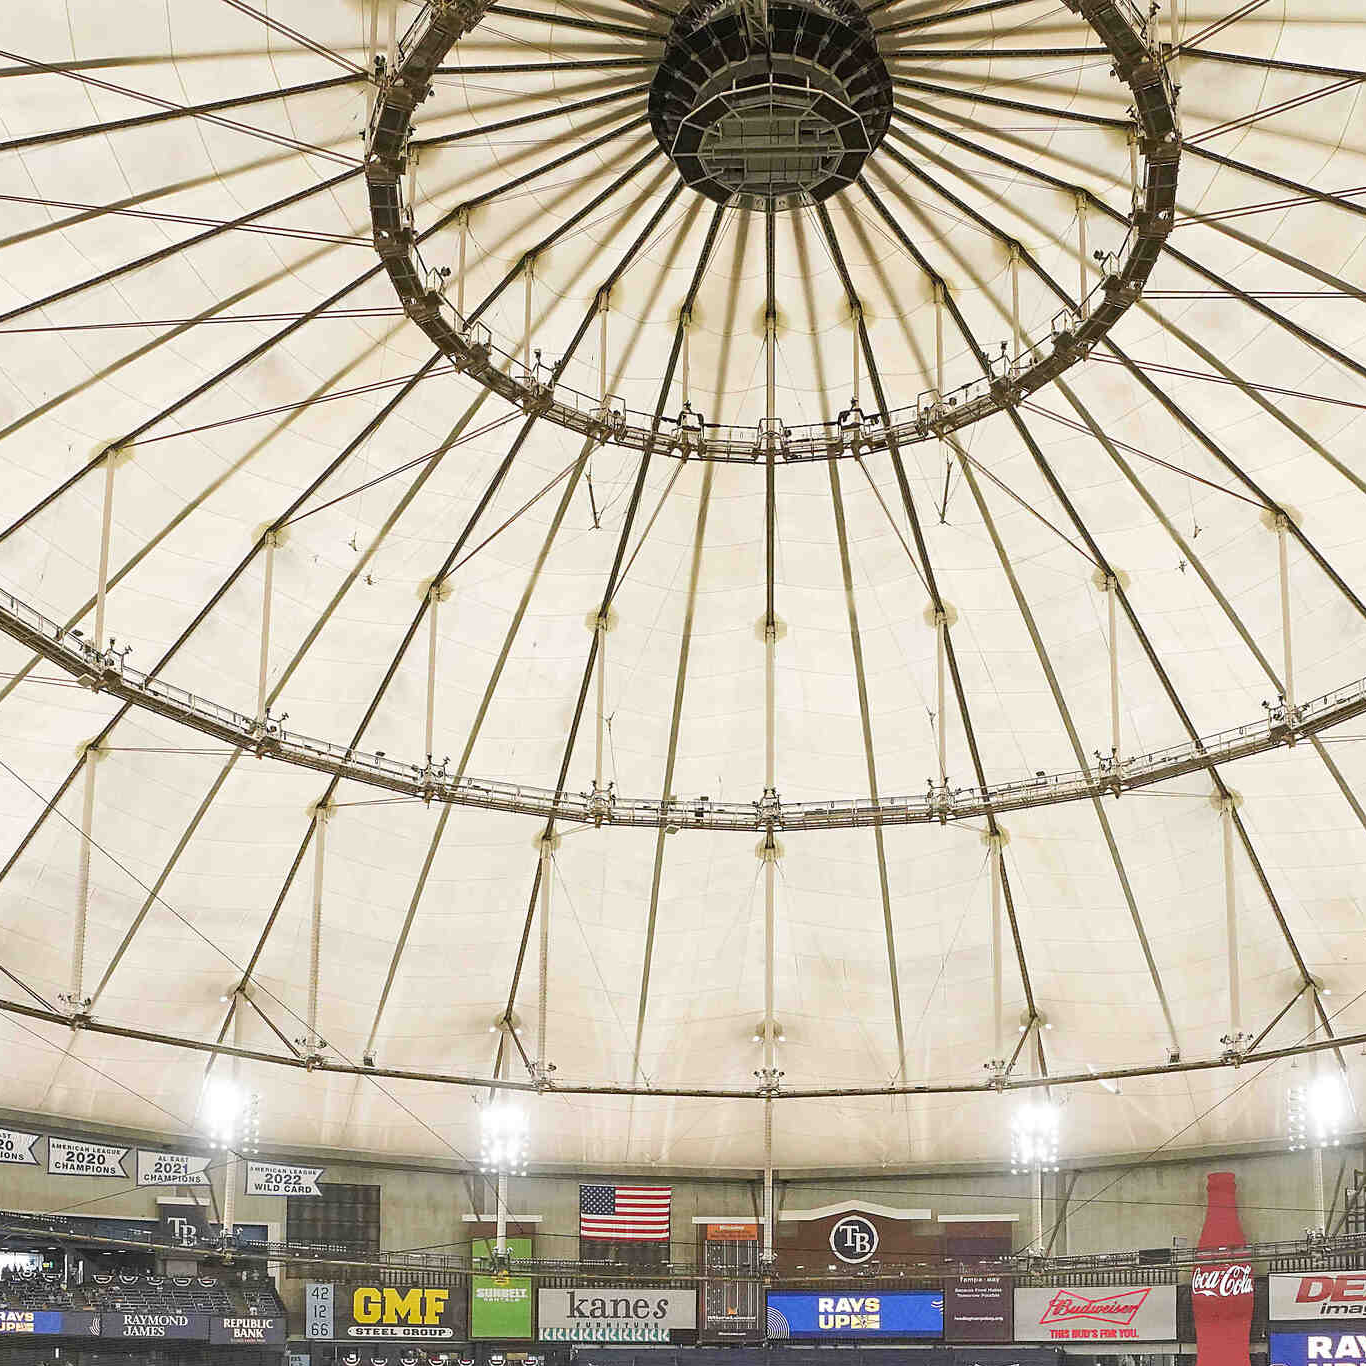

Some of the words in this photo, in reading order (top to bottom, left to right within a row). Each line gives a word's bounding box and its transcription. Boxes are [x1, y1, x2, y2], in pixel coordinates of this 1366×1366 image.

[51, 1143, 90, 1153] AMERICAN
[91, 1146, 122, 1156] LEAGUE
[65, 1151, 106, 1165] 2020
[54, 1161, 116, 1175] CHAMPIONS
[153, 1162, 188, 1175] 2021
[250, 1165, 288, 1174] AMERICAN
[290, 1168, 318, 1177] LEAGUE
[143, 1173, 201, 1184] CHAMPIONS
[264, 1172, 302, 1185] 2022
[254, 1183, 281, 1193] WILD
[283, 1184, 312, 1194] CARD
[167, 1217, 197, 1247] TB
[839, 1225, 871, 1254] TB
[1192, 1264, 1254, 1297] Coca-Cola
[311, 1287, 329, 1300] 42
[353, 1287, 450, 1325] GMF
[566, 1291, 669, 1320] kanes
[818, 1297, 881, 1312] RAYS
[1052, 1299, 1140, 1316] Budweiser
[313, 1305, 327, 1318] 12
[123, 1314, 189, 1327] RAYMOND
[223, 1318, 274, 1330] REPUBLIC
[575, 1321, 660, 1329] FURNITURE
[818, 1315, 850, 1329] UP
[123, 1326, 165, 1337] JAMES
[234, 1328, 264, 1339] BANK
[311, 1323, 329, 1336] 66
[355, 1328, 398, 1336] STEEL
[403, 1328, 446, 1337] GROUP
[1050, 1329, 1070, 1339] THIS
[1072, 1329, 1098, 1338] BUD'S
[1100, 1329, 1116, 1338] FOR
[1118, 1329, 1140, 1338] YOU.
